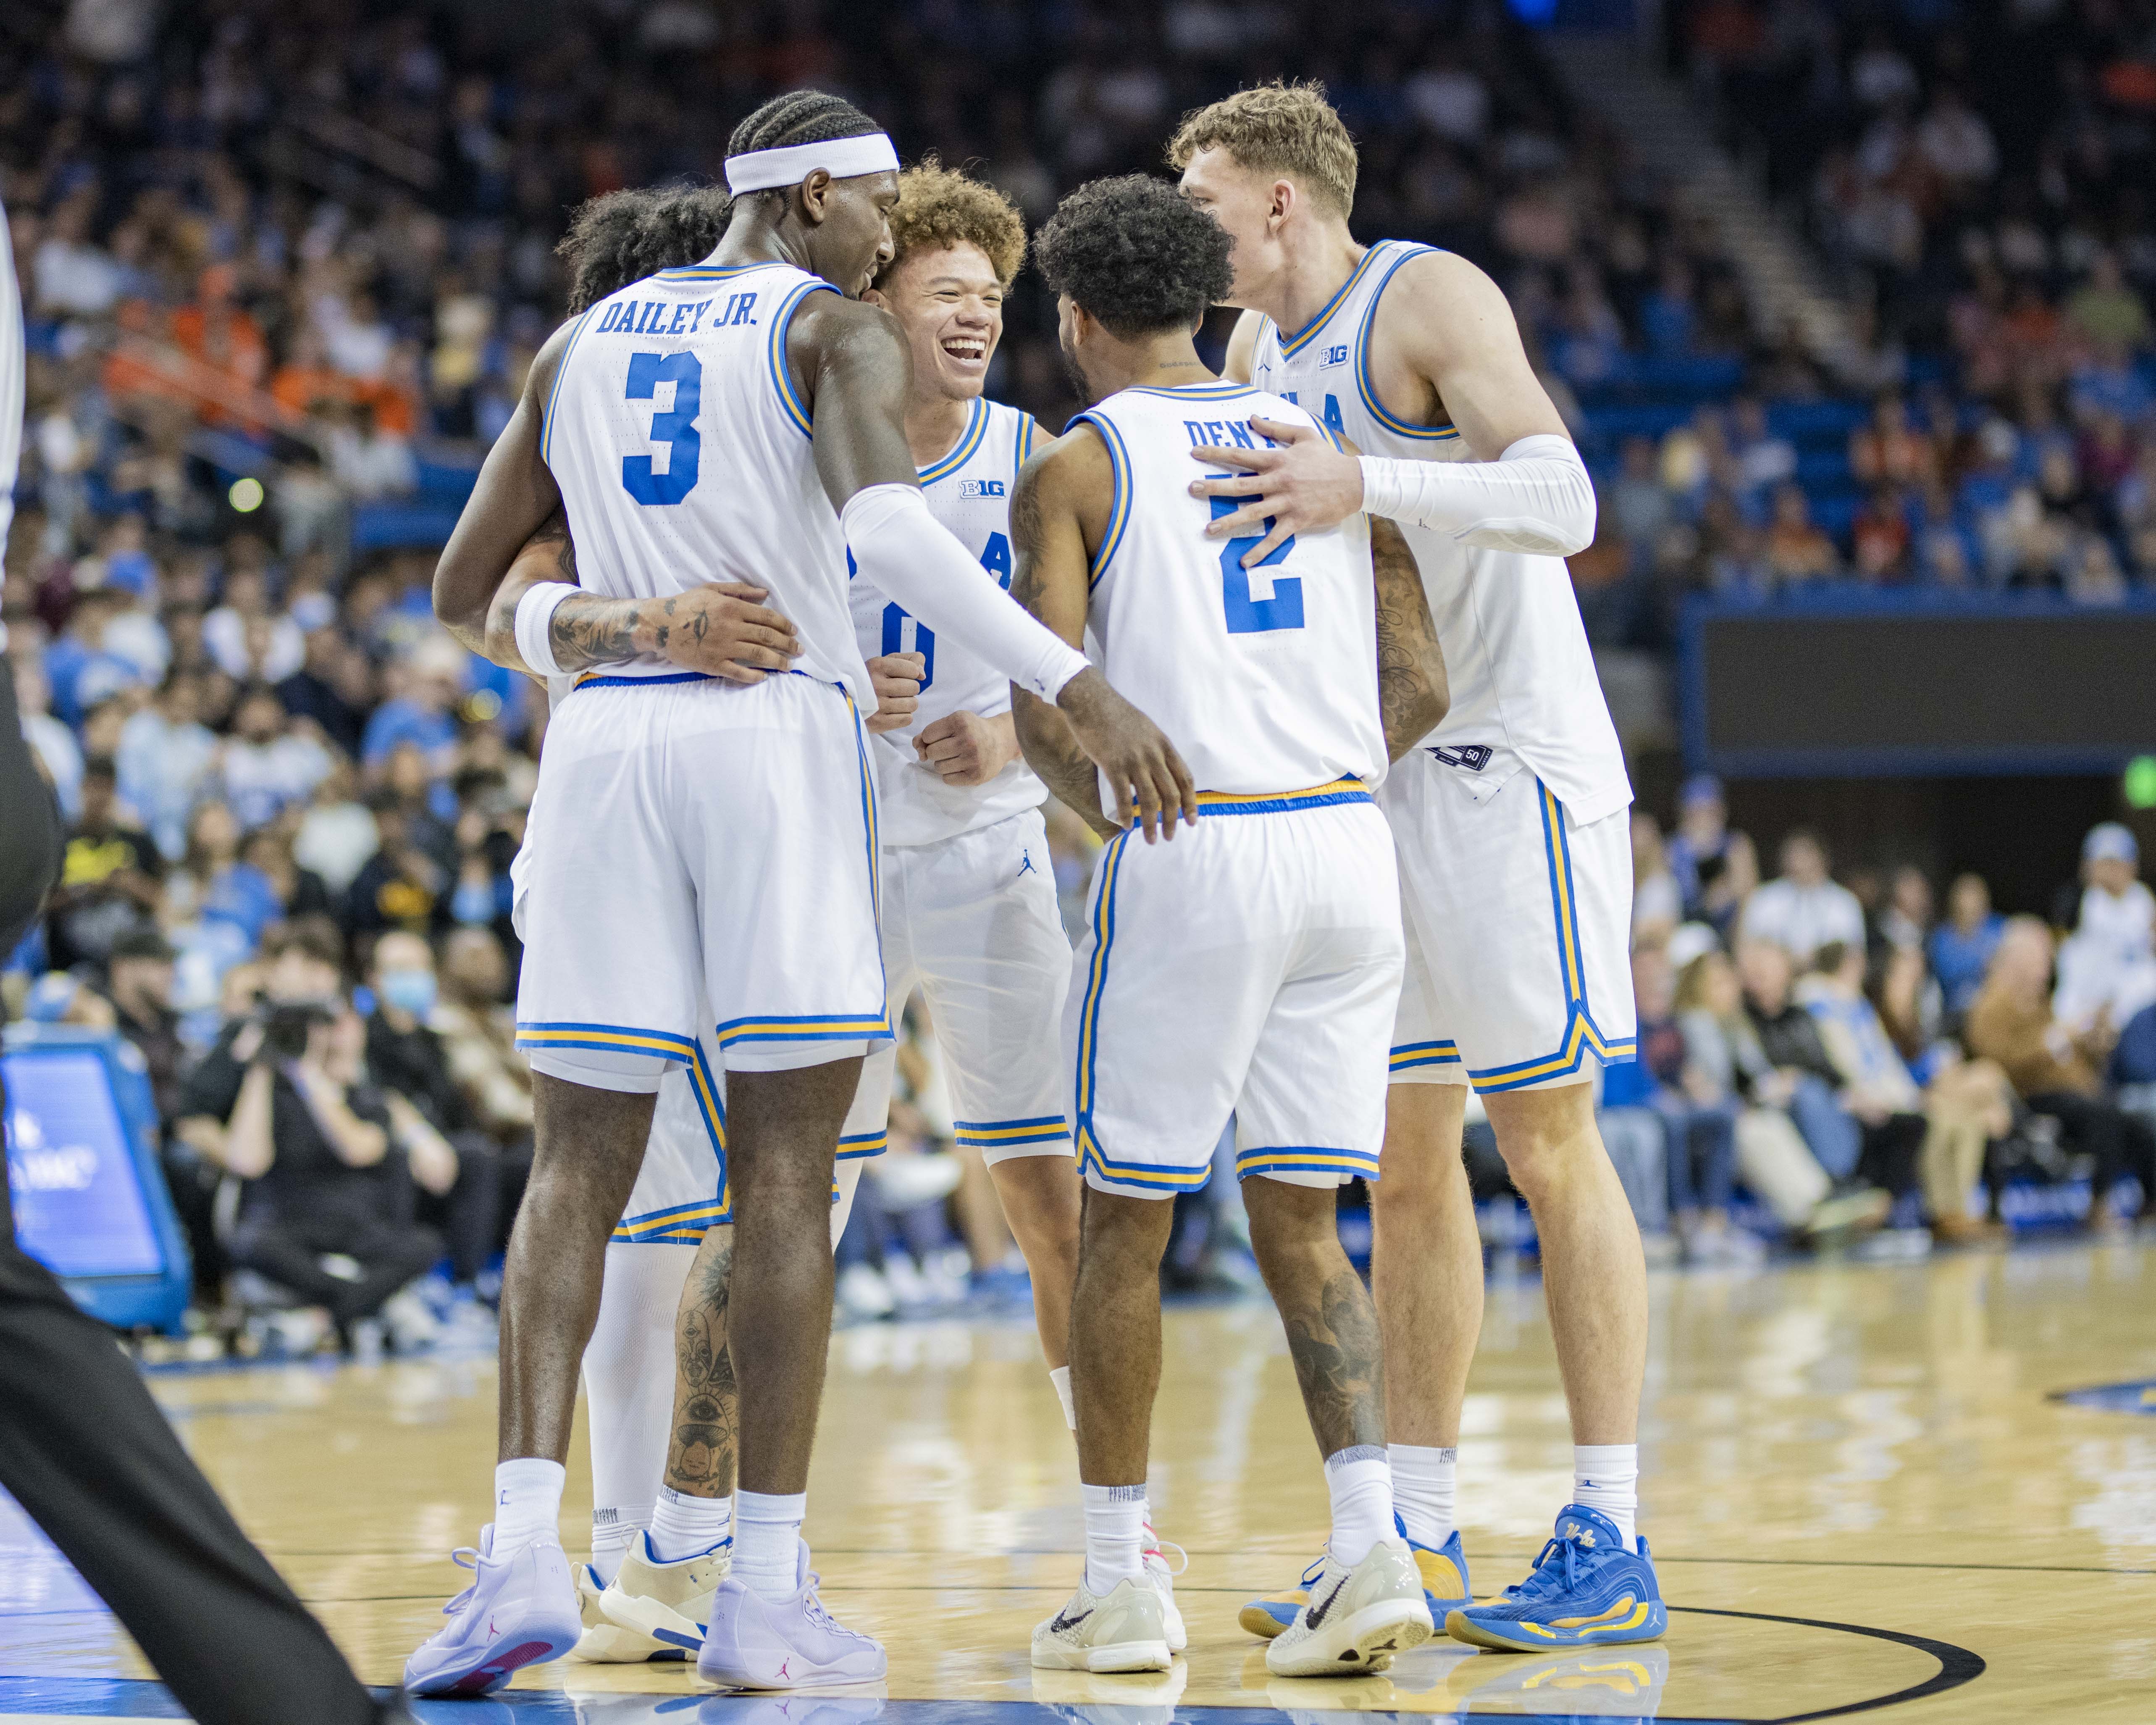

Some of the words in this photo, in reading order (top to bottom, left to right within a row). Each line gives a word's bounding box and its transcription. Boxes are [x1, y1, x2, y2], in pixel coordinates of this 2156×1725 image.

[596, 299, 712, 334] DAILEY
[714, 293, 758, 328] JR.
[622, 350, 702, 505] 3
[1205, 472, 1305, 634] 2
[1465, 749, 1479, 761] 50
